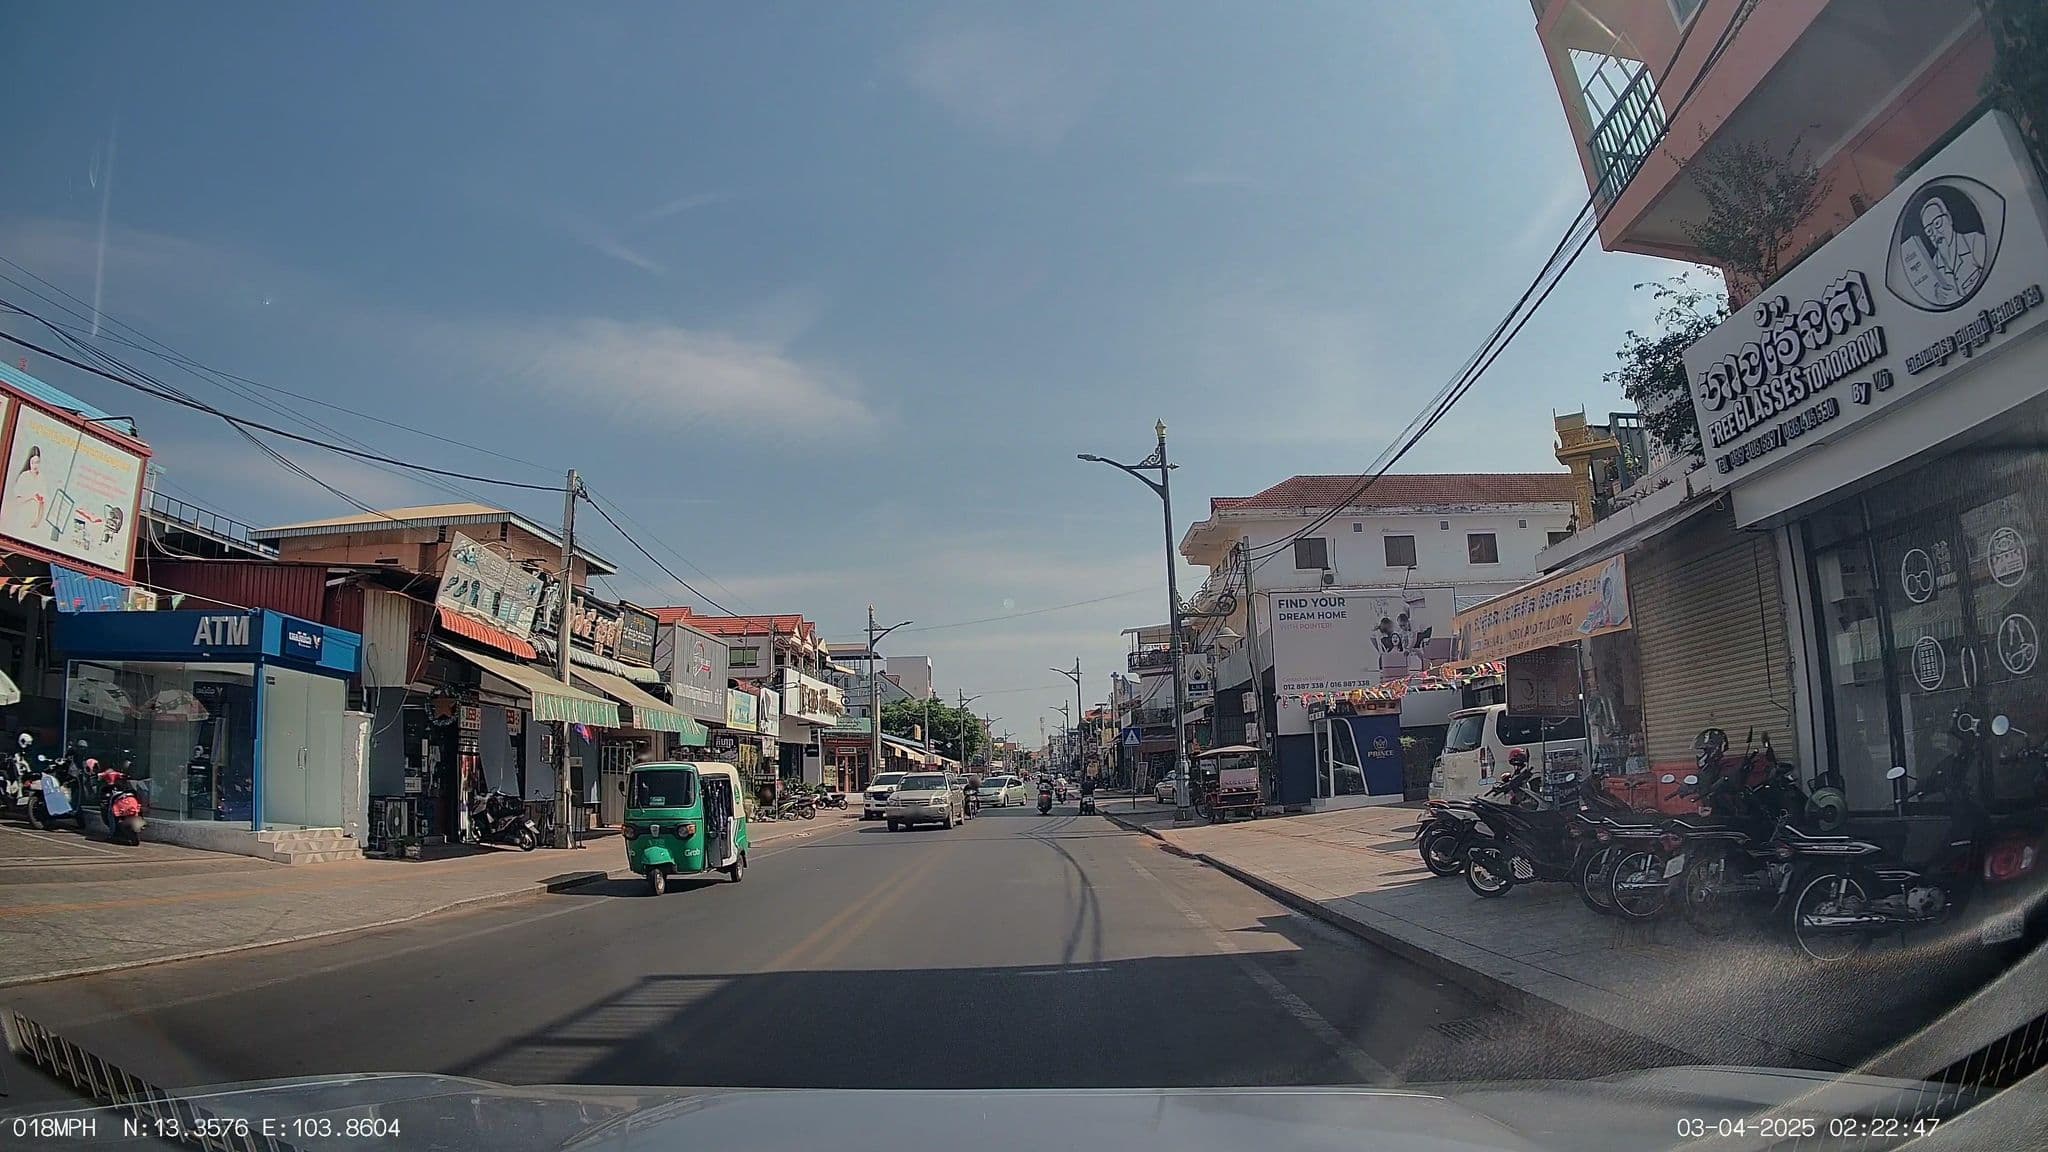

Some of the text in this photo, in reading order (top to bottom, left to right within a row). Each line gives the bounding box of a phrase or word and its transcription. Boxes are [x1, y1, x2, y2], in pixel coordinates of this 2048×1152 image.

[1707, 412, 1738, 448] FREE
[1733, 365, 1808, 434] GLASSES
[1803, 326, 1887, 397] TOMORROW
[1852, 382, 1871, 405] By
[1278, 597, 1346, 609] FIND YOUR
[1279, 611, 1347, 621] DREAM HOME
[193, 615, 250, 646] ATM
[1325, 681, 1329, 689] /
[1367, 749, 1394, 758] PRINCE
[684, 848, 701, 857] Grab
